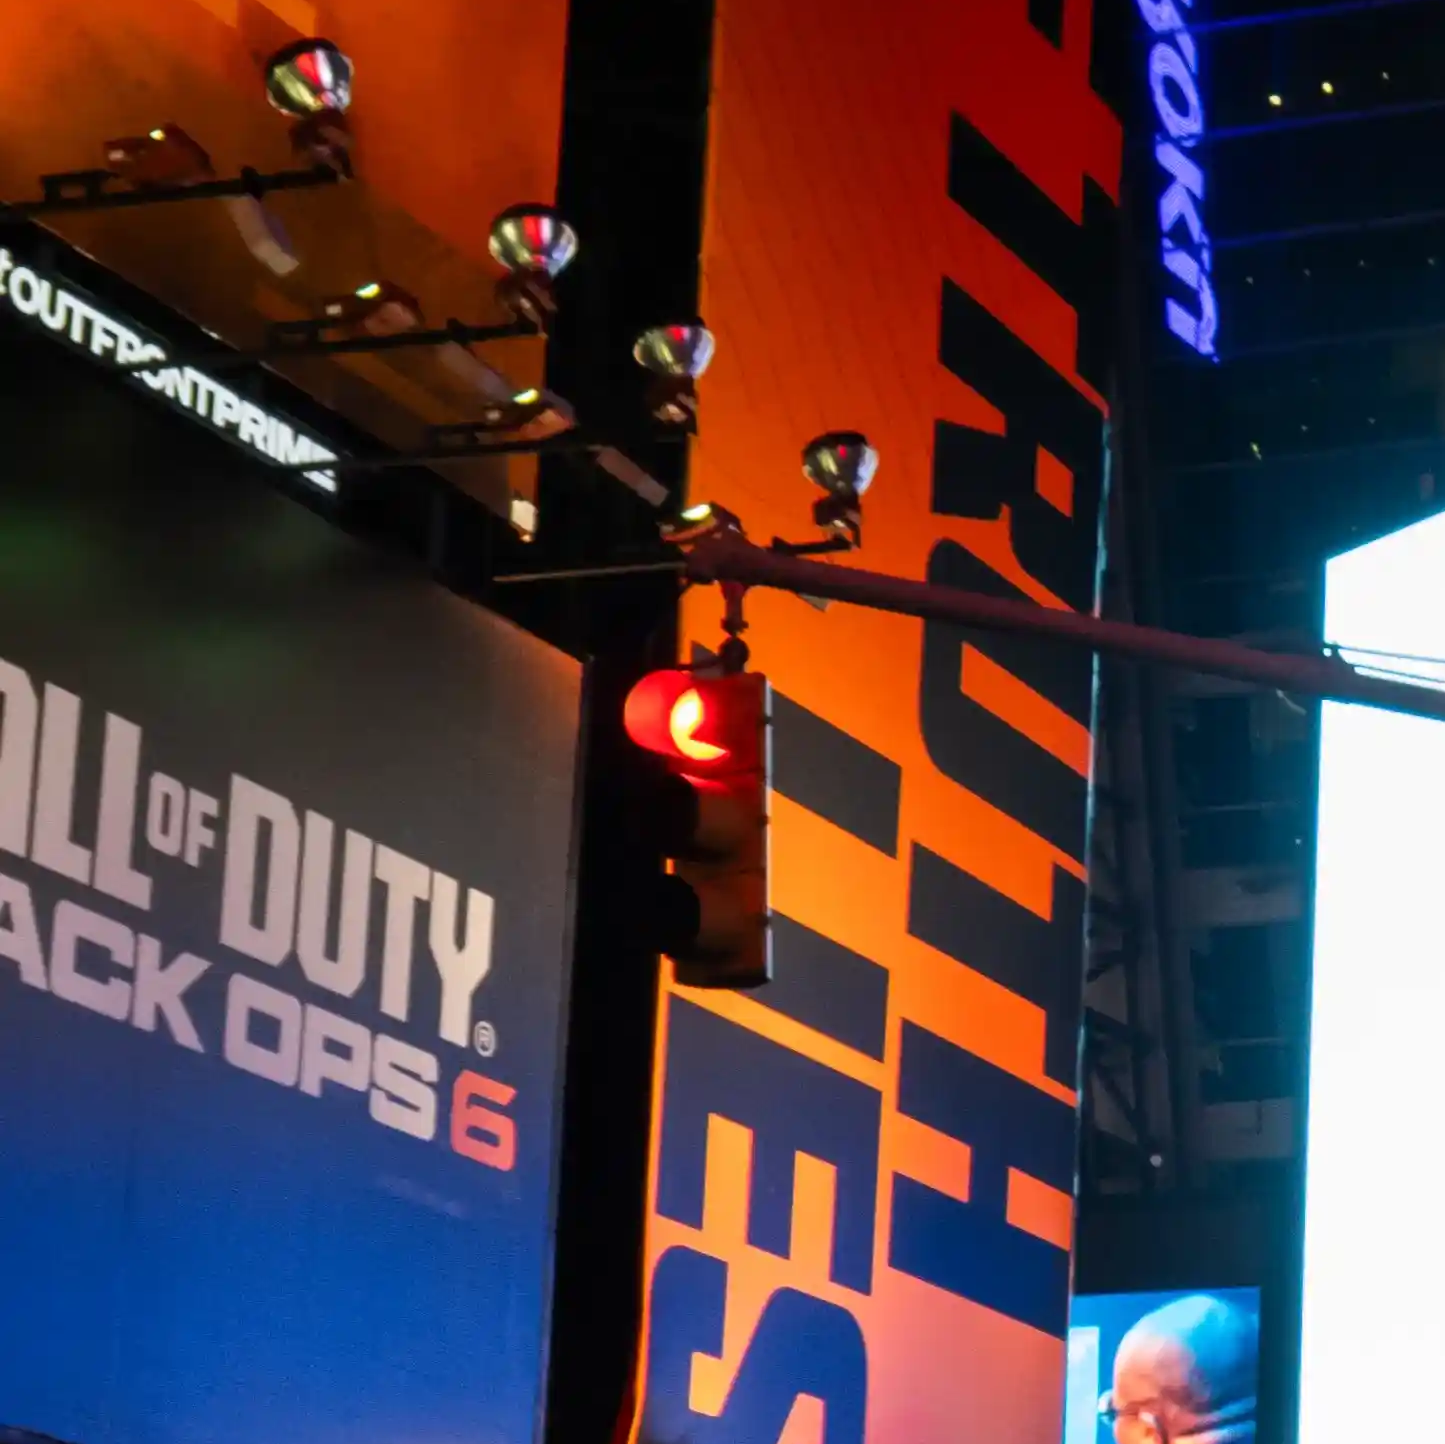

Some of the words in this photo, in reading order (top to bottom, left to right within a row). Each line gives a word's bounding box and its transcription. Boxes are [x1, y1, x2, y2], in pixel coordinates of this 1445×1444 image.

[889, 110, 1120, 1343] TRUTH
[146, 771, 219, 868] OF
[219, 773, 495, 1049] DUTY
[224, 972, 439, 1141] OPS
[449, 1069, 517, 1172] 6
